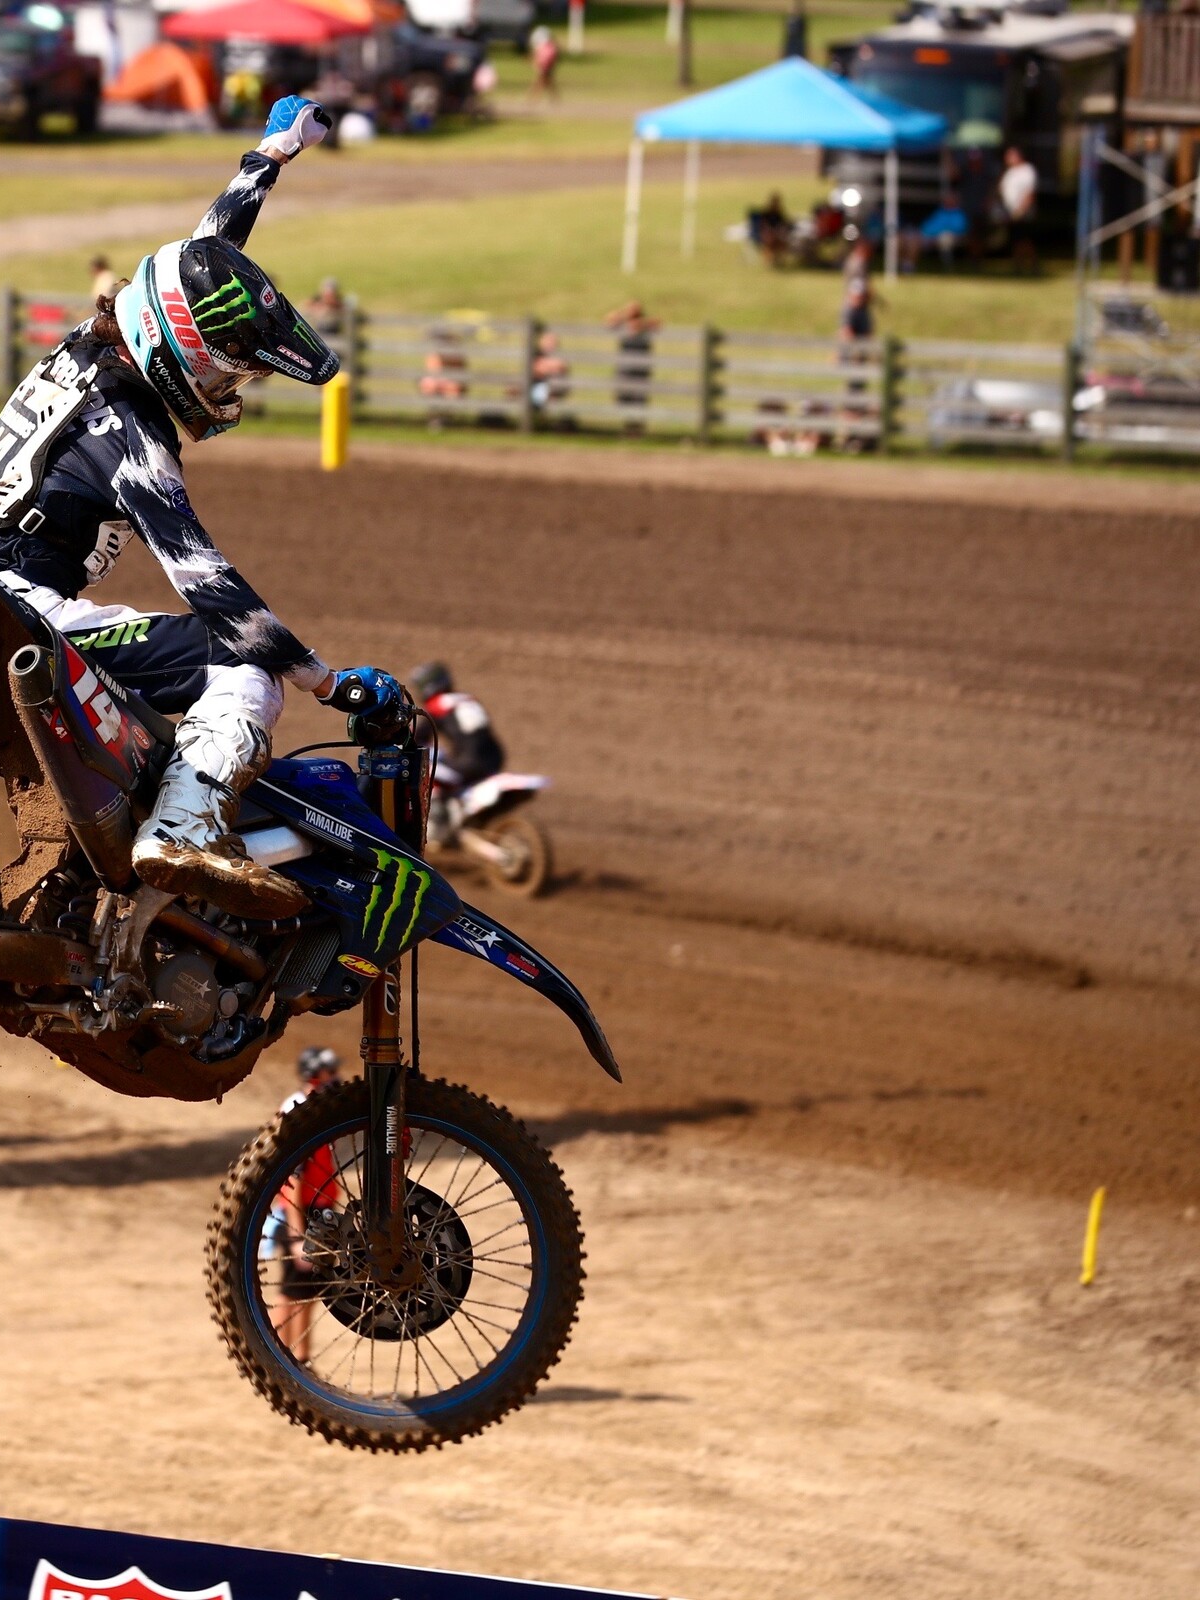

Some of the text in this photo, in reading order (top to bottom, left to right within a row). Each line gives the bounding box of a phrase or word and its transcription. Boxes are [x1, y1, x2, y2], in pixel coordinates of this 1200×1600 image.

[142, 311, 157, 341] BELL
[68, 618, 151, 651] HOR
[95, 663, 128, 703] YAMAHA
[305, 808, 354, 842] YAMALUBE
[386, 1105, 398, 1155] YAMALUBE
